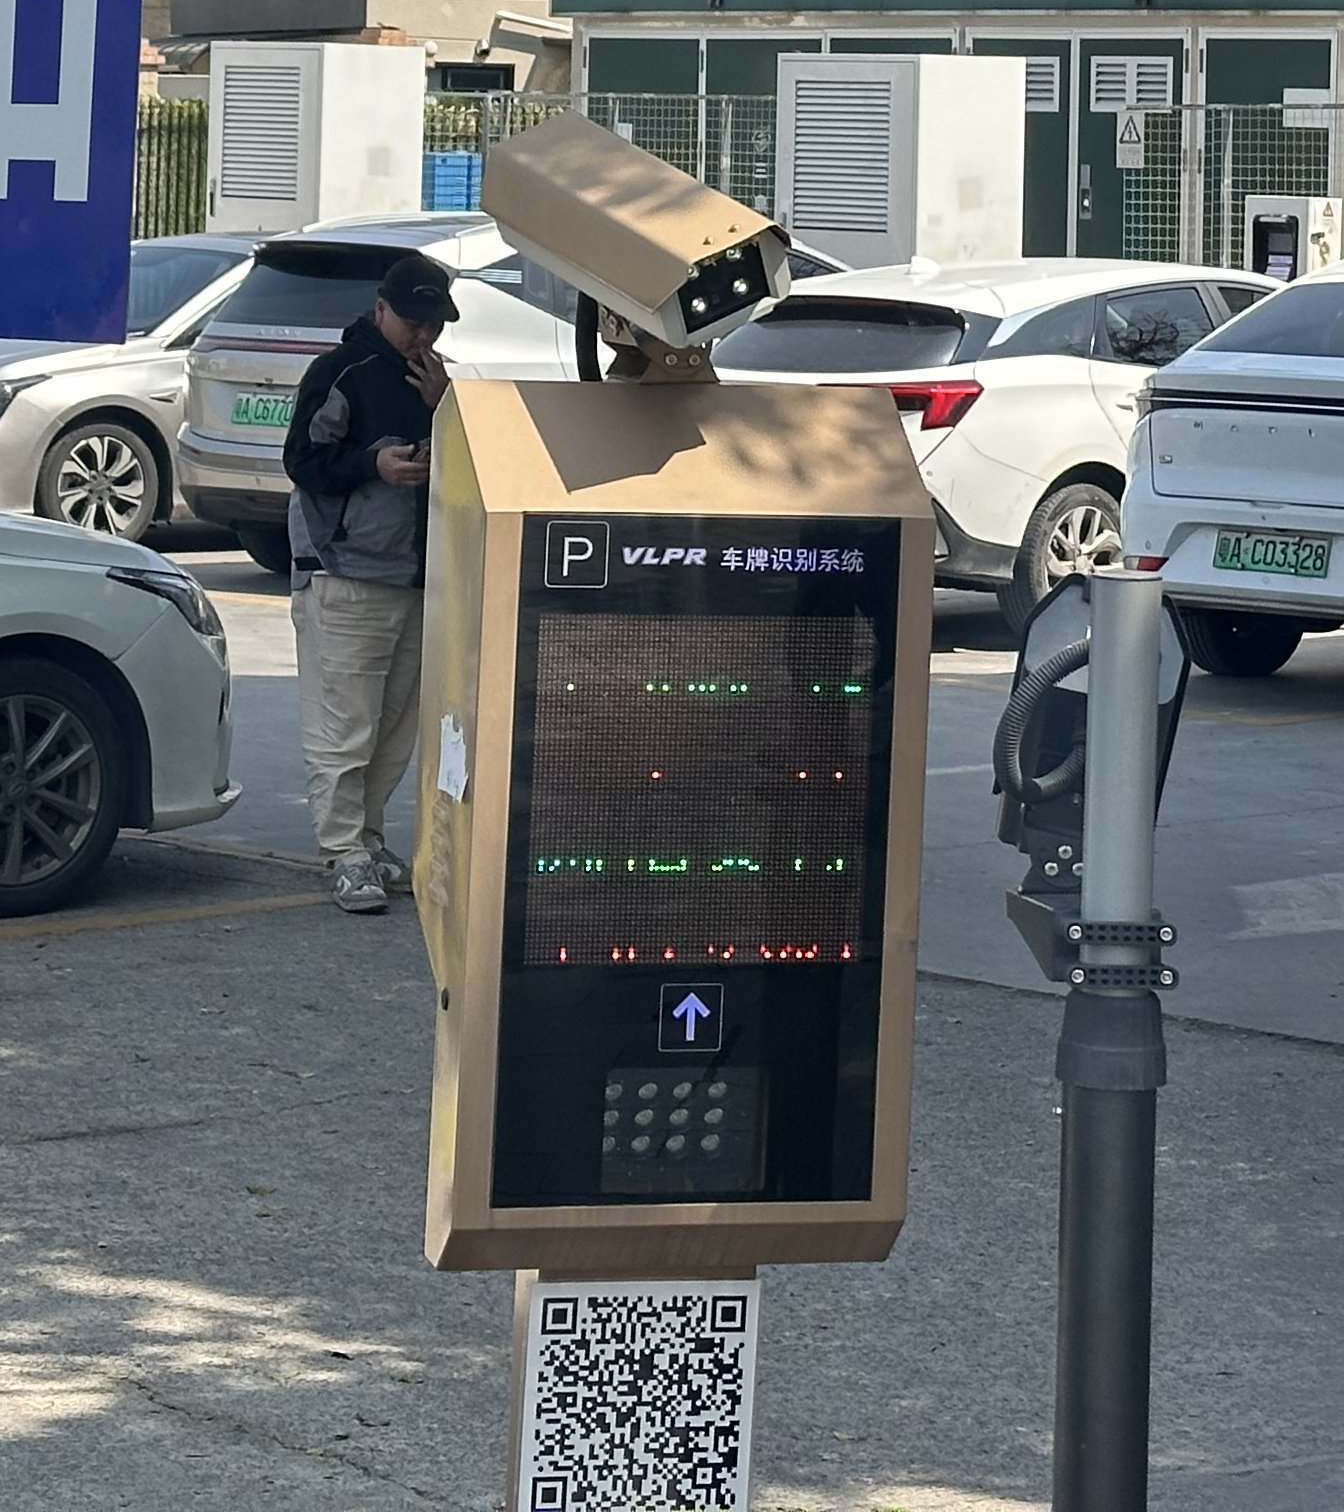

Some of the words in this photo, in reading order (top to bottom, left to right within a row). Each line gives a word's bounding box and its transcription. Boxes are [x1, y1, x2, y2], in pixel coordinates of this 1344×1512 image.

[561, 536, 594, 578] P
[622, 546, 707, 567] VLPR
[720, 545, 865, 573] 车牌识别系统
